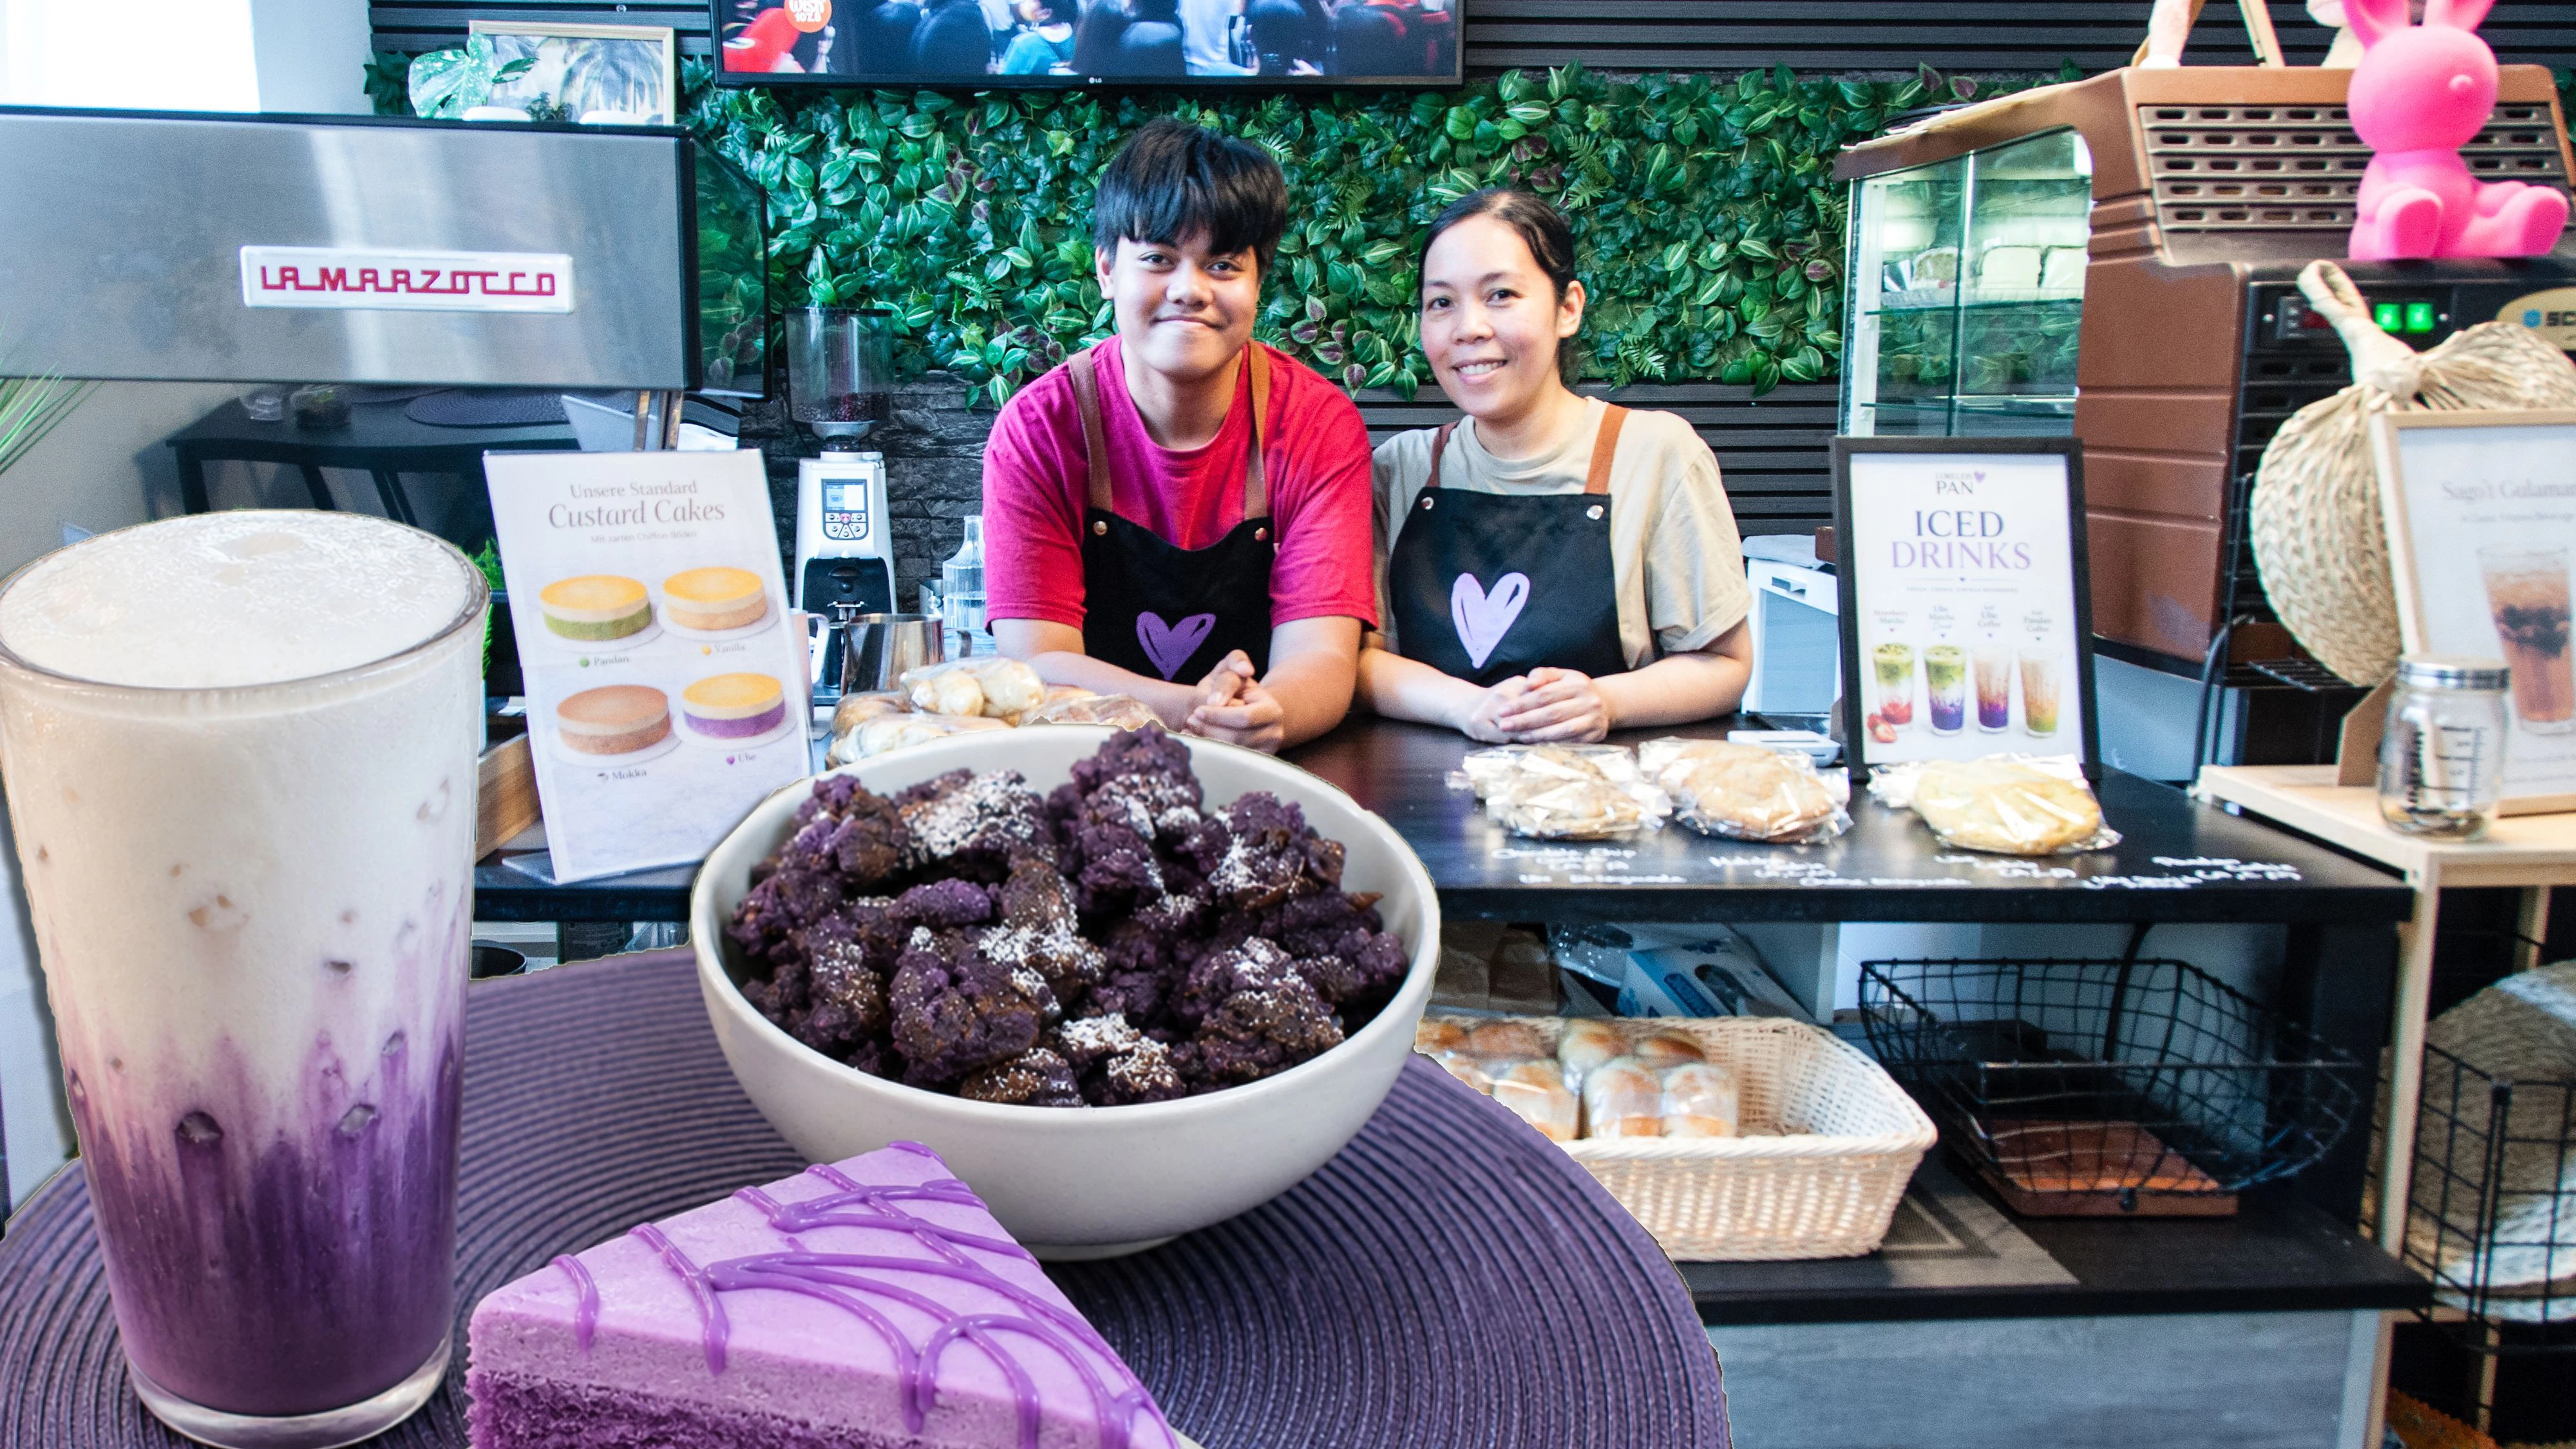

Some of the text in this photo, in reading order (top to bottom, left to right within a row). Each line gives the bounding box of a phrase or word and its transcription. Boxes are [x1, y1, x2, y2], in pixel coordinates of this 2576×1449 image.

[260, 265, 555, 296] LA MARZOCCO
[569, 480, 699, 499] Unsere Standard
[1935, 480, 1975, 495] PAN
[548, 498, 725, 529] Custard Cakes
[1915, 509, 2005, 538] ICED
[1891, 541, 2032, 571] DRINKS
[593, 654, 630, 667] Pandan
[737, 752, 757, 762] Ube
[612, 768, 647, 781] Mokka
